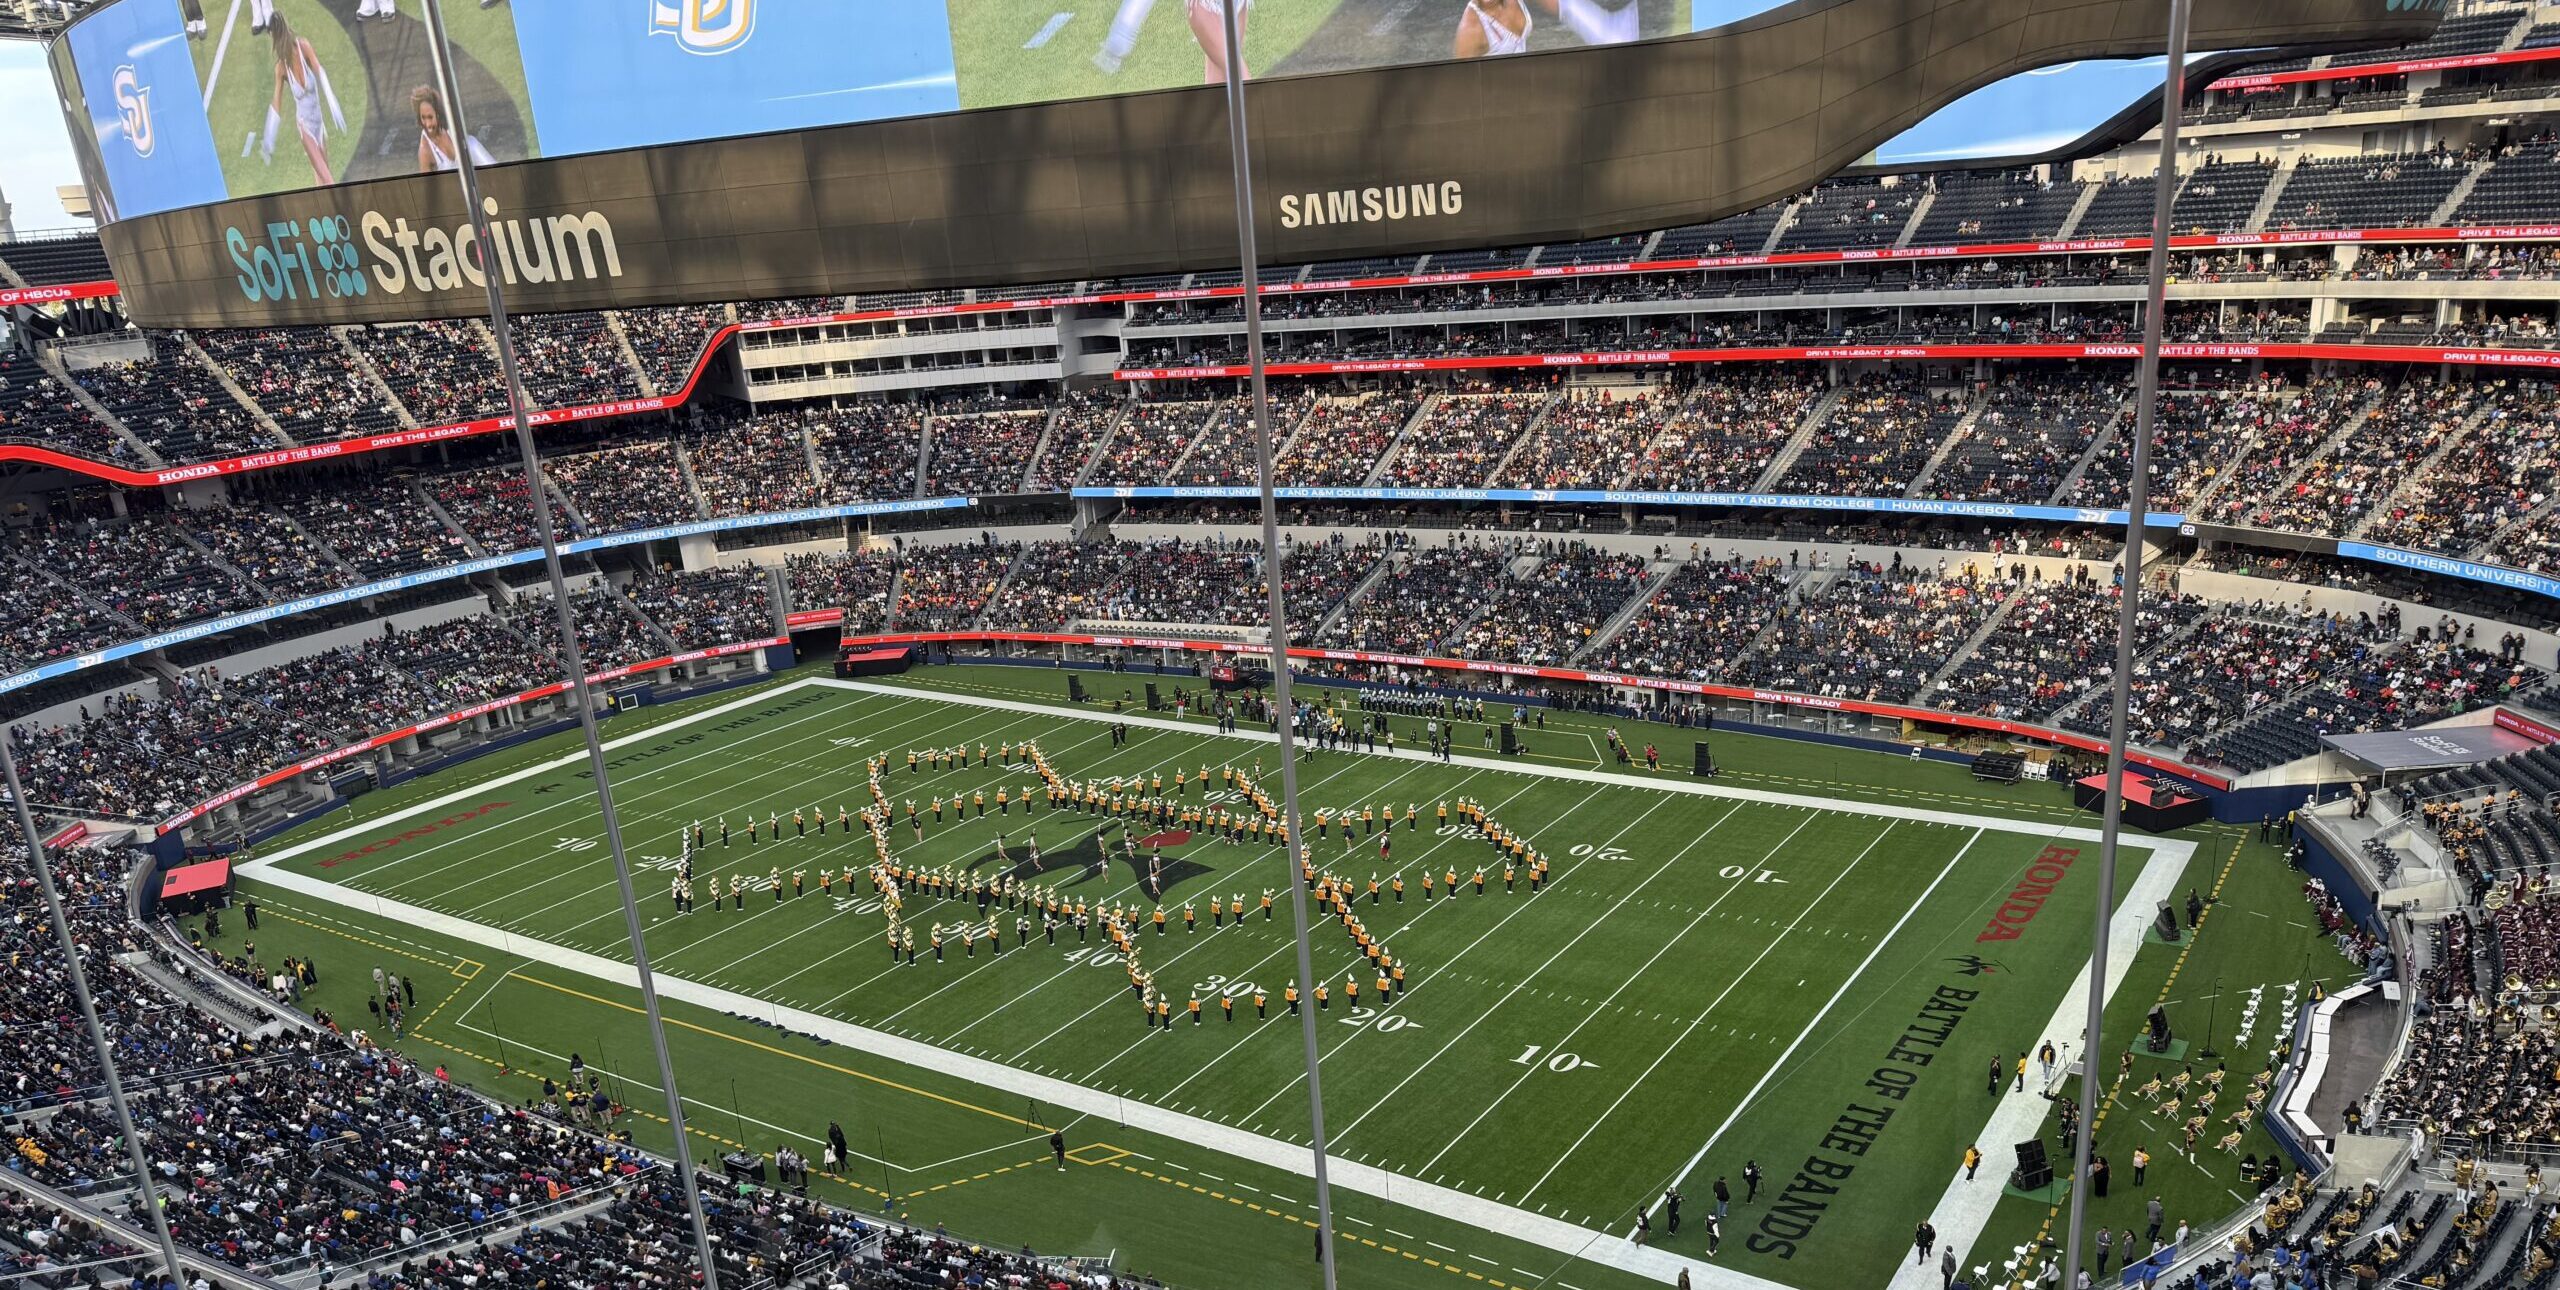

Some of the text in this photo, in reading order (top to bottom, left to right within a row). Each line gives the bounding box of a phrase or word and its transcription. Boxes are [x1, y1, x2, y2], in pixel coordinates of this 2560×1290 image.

[2433, 61, 2462, 69] LEGACY
[1280, 180, 1463, 229] SAMSUNG
[2216, 230, 2361, 243] HONDA BATTLE OF THE BANDS
[2495, 228, 2516, 236] THE
[2520, 227, 2560, 236] LEGAC
[1892, 249, 1910, 257] BATTLE
[1922, 248, 1933, 256] THE
[2088, 240, 2126, 248] LEGACY
[225, 219, 319, 302] SoFi
[1738, 256, 1768, 264] LEGACY
[1533, 267, 1564, 276] HONDA
[1, 288, 72, 302] OF HBCUs
[742, 321, 772, 329] HONDA
[1598, 354, 1622, 362] BATTLE
[2084, 346, 2259, 355] HONDA BATTLE OF THE BANDS
[2480, 353, 2500, 361] THE
[2504, 354, 2549, 363] LEGACY
[1120, 370, 1154, 379] HONDA
[499, 399, 663, 428] HDA BATTLE OF THE BANDS
[371, 425, 470, 447] DRIVE THE LEGACY
[157, 444, 341, 483] HONDA BATTLE OF THE BANDS
[1174, 488, 1226, 496] SOUTHERN
[1311, 489, 1333, 497] A&M
[1396, 490, 1436, 498] HUMAN
[1605, 493, 2014, 515] SOUTHERN UNIVERSITY AND A&M COLLEGE HUMAN JUKEBOX
[602, 499, 945, 545] SOUTHERN UNIVERSITY AND A&M COLLEGE HUMAN JUKEBOX
[2183, 526, 2194, 534] CC
[2376, 549, 2560, 594] SOUTHERN UNIVERSITY
[142, 556, 514, 650] SOUTHERN UNIVERSITY AND A&M COLLEGE HUMAN JUKEBOX
[1094, 636, 1123, 644] HONDA
[1222, 643, 1273, 653] DRIVE THE LEG
[673, 651, 707, 662] HONDA
[1467, 662, 1490, 670] DRIVE
[1508, 665, 1539, 675] LEGACY
[1585, 673, 1622, 684] HONDA
[1636, 679, 1659, 688] BATTLE
[1669, 682, 1681, 690] THE
[1682, 683, 1702, 692] BANDS
[1754, 691, 1841, 708] DRIVE THE LEGACY
[2497, 714, 2519, 727] HONDA
[572, 691, 836, 780] BTTLE OF THE BANDS
[2408, 737, 2452, 756] Stadium
[166, 811, 195, 829] HONDA
[313, 801, 512, 868] HONDA
[551, 838, 598, 852] 10
[1569, 843, 1628, 860] 20
[1718, 865, 1781, 885] 10
[1976, 844, 2080, 943] HONDA
[833, 896, 883, 914] 40
[1063, 947, 1119, 967] 40
[1193, 974, 1255, 998] 30
[1338, 1007, 1407, 1032] 20
[1509, 1044, 1581, 1072] 10
[1745, 984, 1980, 1261] BATTLE OF THE BANDS
